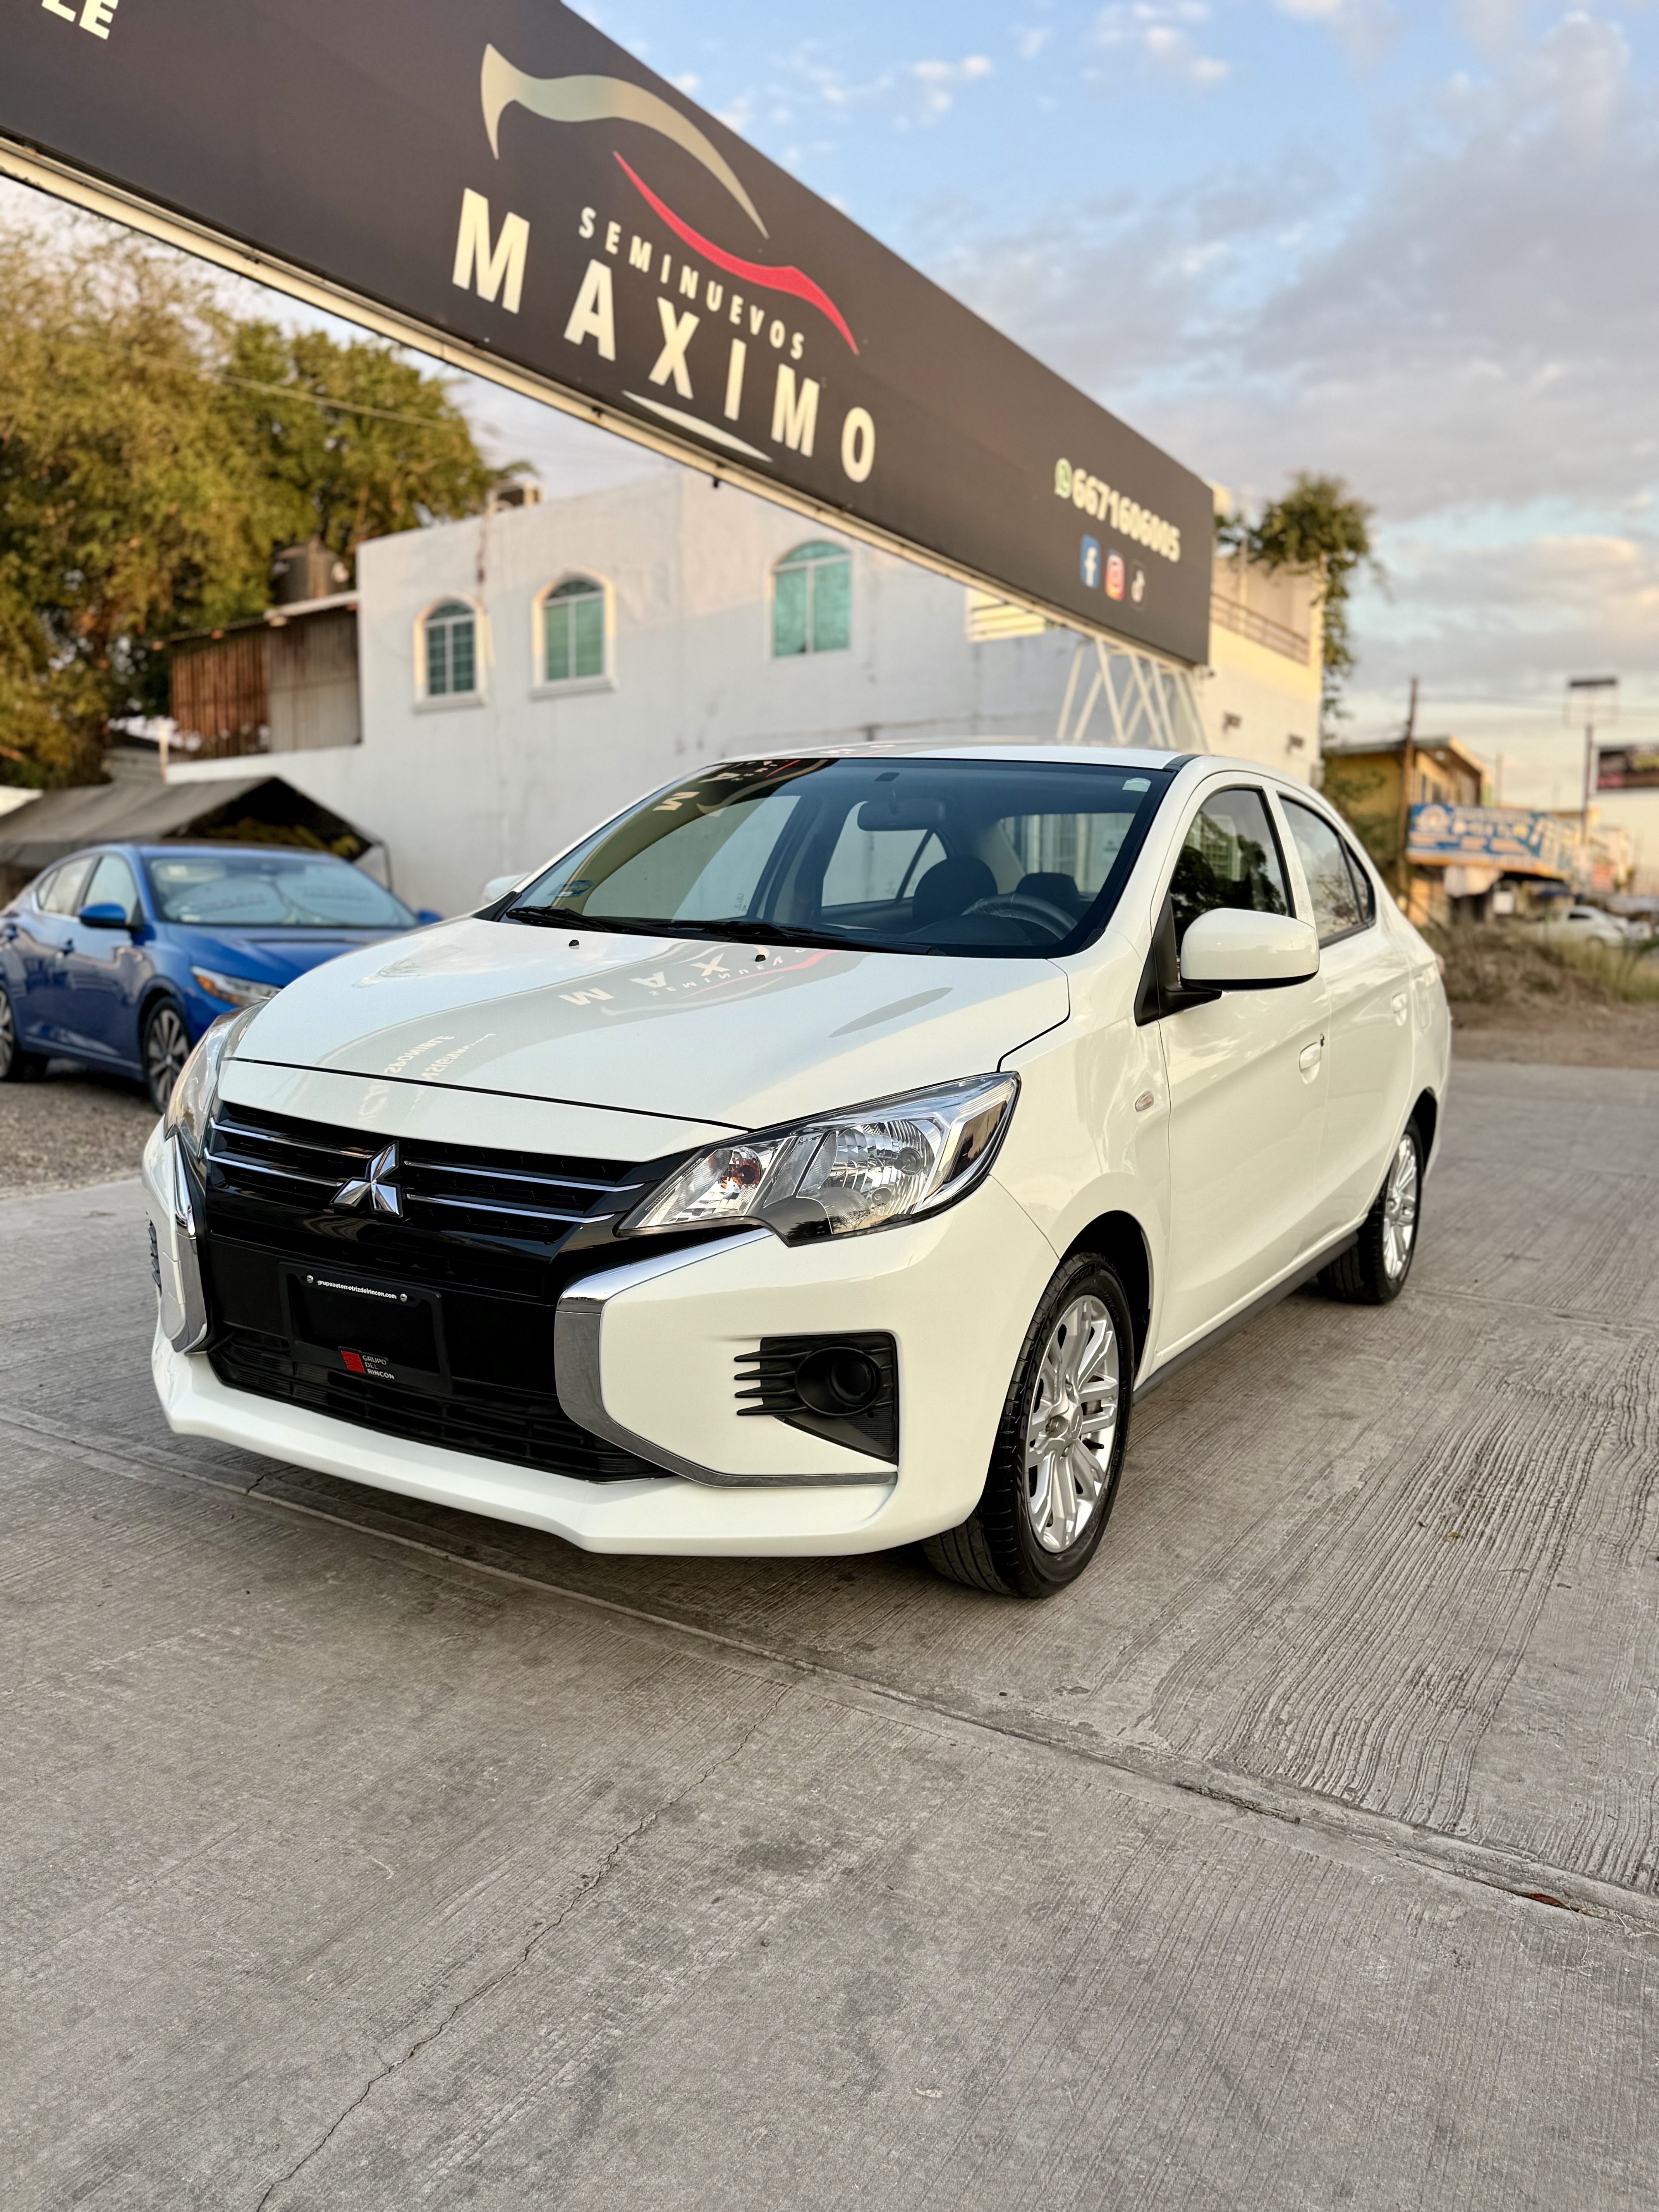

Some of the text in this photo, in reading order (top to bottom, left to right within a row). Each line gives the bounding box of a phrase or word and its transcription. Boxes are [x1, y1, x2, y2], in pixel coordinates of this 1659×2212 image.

[579, 207, 804, 360] SEMINUEVOS
[452, 187, 875, 483] MAXIMO
[317, 1280, 397, 1299] grupoautomotrizdelrincon.com
[362, 1355, 387, 1365] GRUPO
[364, 1362, 379, 1370] DEL
